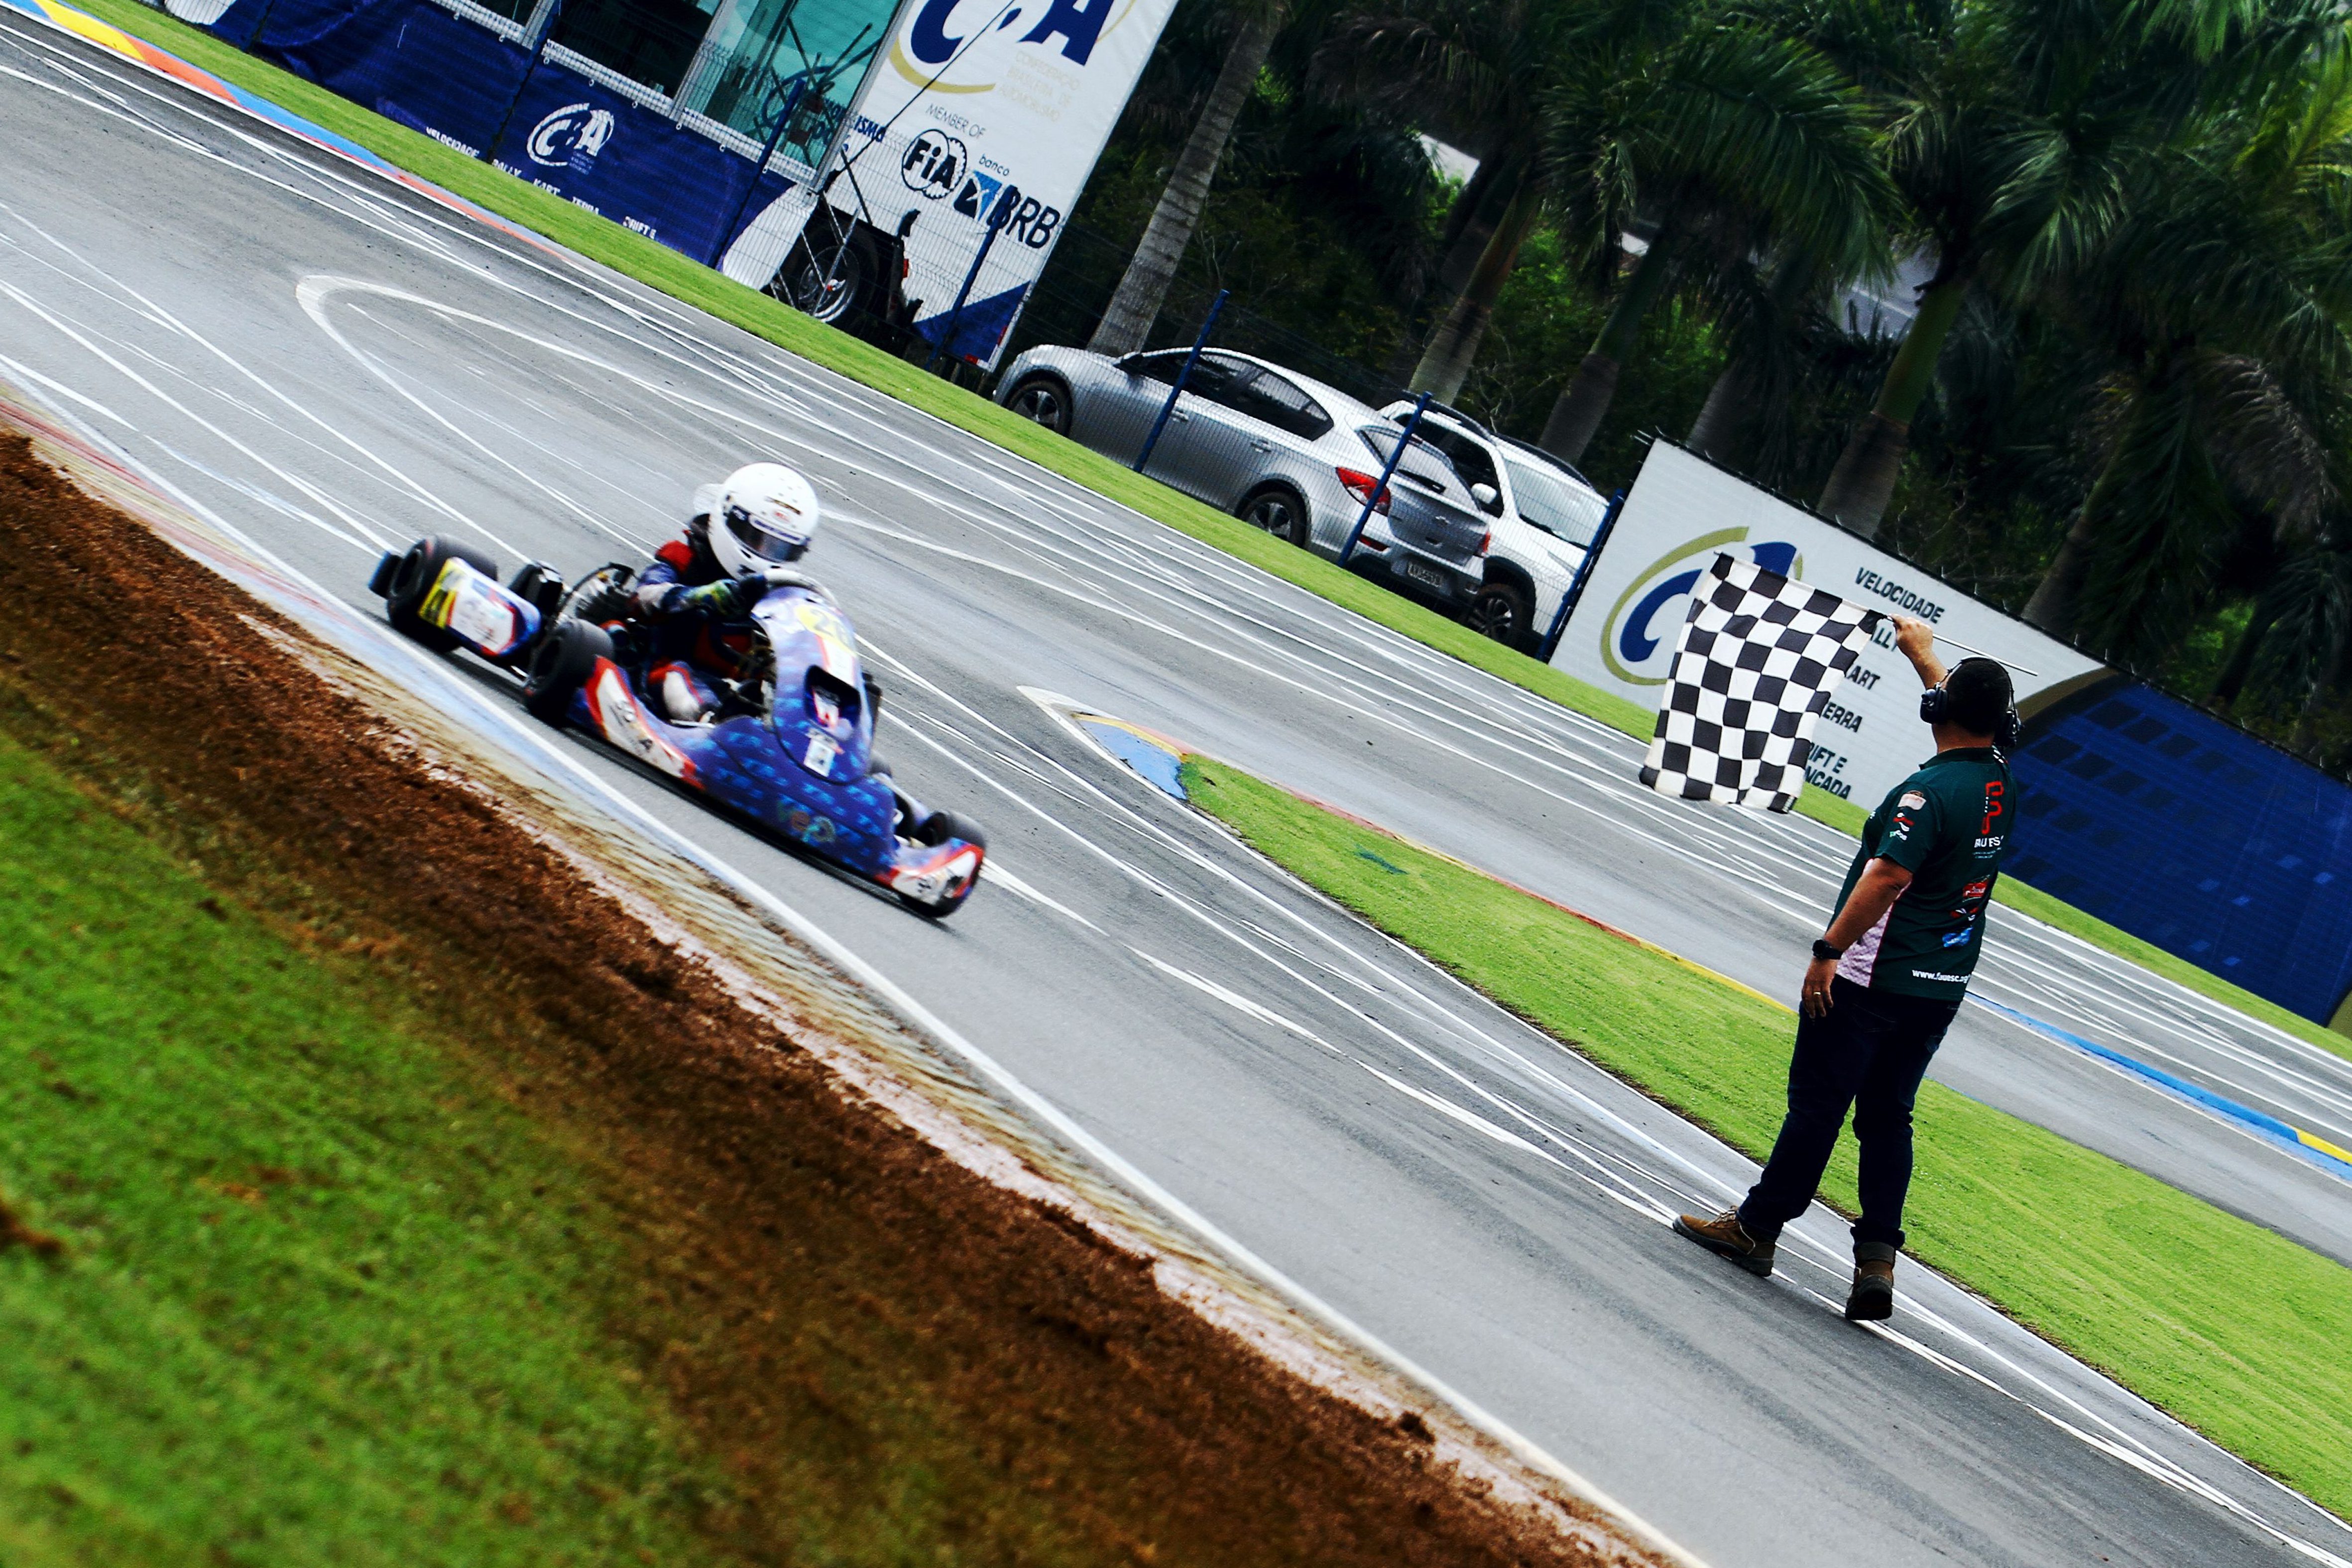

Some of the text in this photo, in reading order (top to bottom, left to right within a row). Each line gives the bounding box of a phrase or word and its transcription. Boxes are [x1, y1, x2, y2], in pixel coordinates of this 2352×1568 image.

[926, 103, 986, 139] MEMBER OF
[978, 154, 1010, 177] banco
[986, 184, 1060, 249] BRB
[1855, 566, 1945, 624] VELOCIDADE
[1846, 665, 1881, 690] ART
[1822, 702, 1863, 733] ERRA
[1832, 756, 1848, 774] E
[1804, 765, 1852, 800] NCADA
